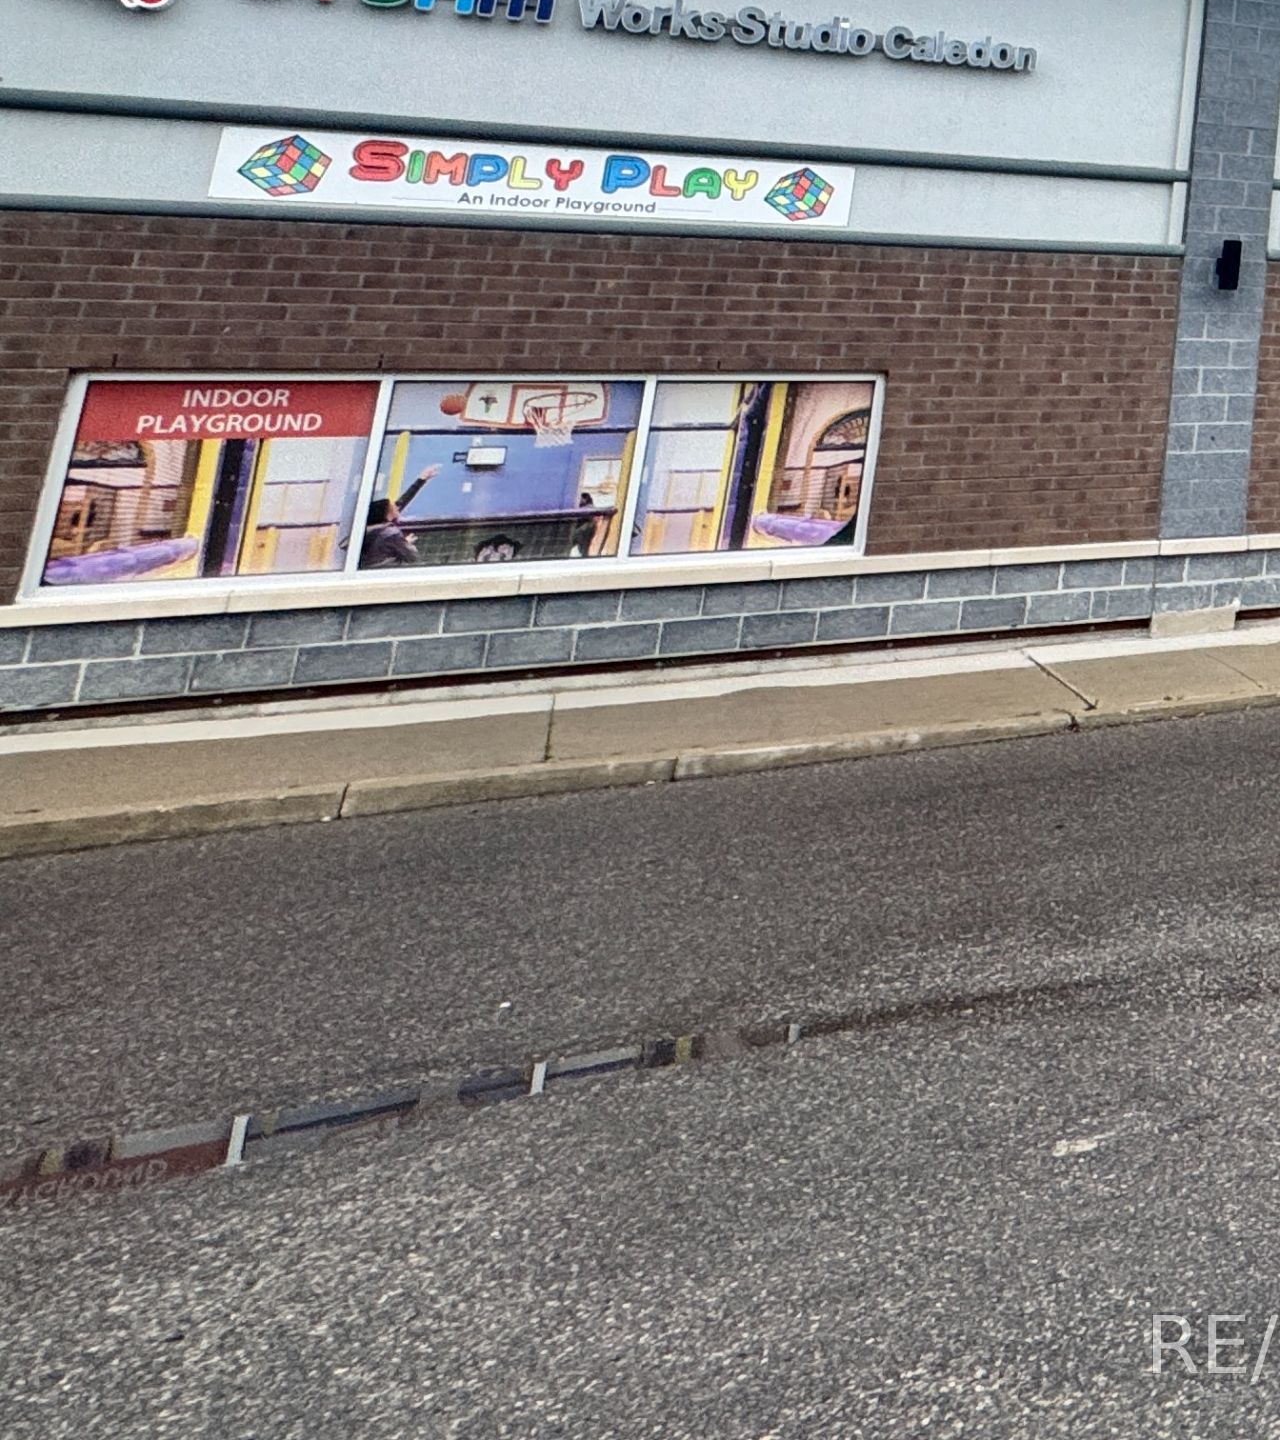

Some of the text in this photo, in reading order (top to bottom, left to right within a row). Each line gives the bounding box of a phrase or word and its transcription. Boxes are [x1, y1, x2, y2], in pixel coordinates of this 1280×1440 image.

[732, 6, 874, 56] Studio
[882, 26, 1038, 72] Caledon
[349, 139, 759, 201] SIMPLY PLAY
[457, 192, 657, 213] An Indoor Playground
[182, 389, 290, 408] INDOOR
[136, 413, 322, 434] PLAYGROUND
